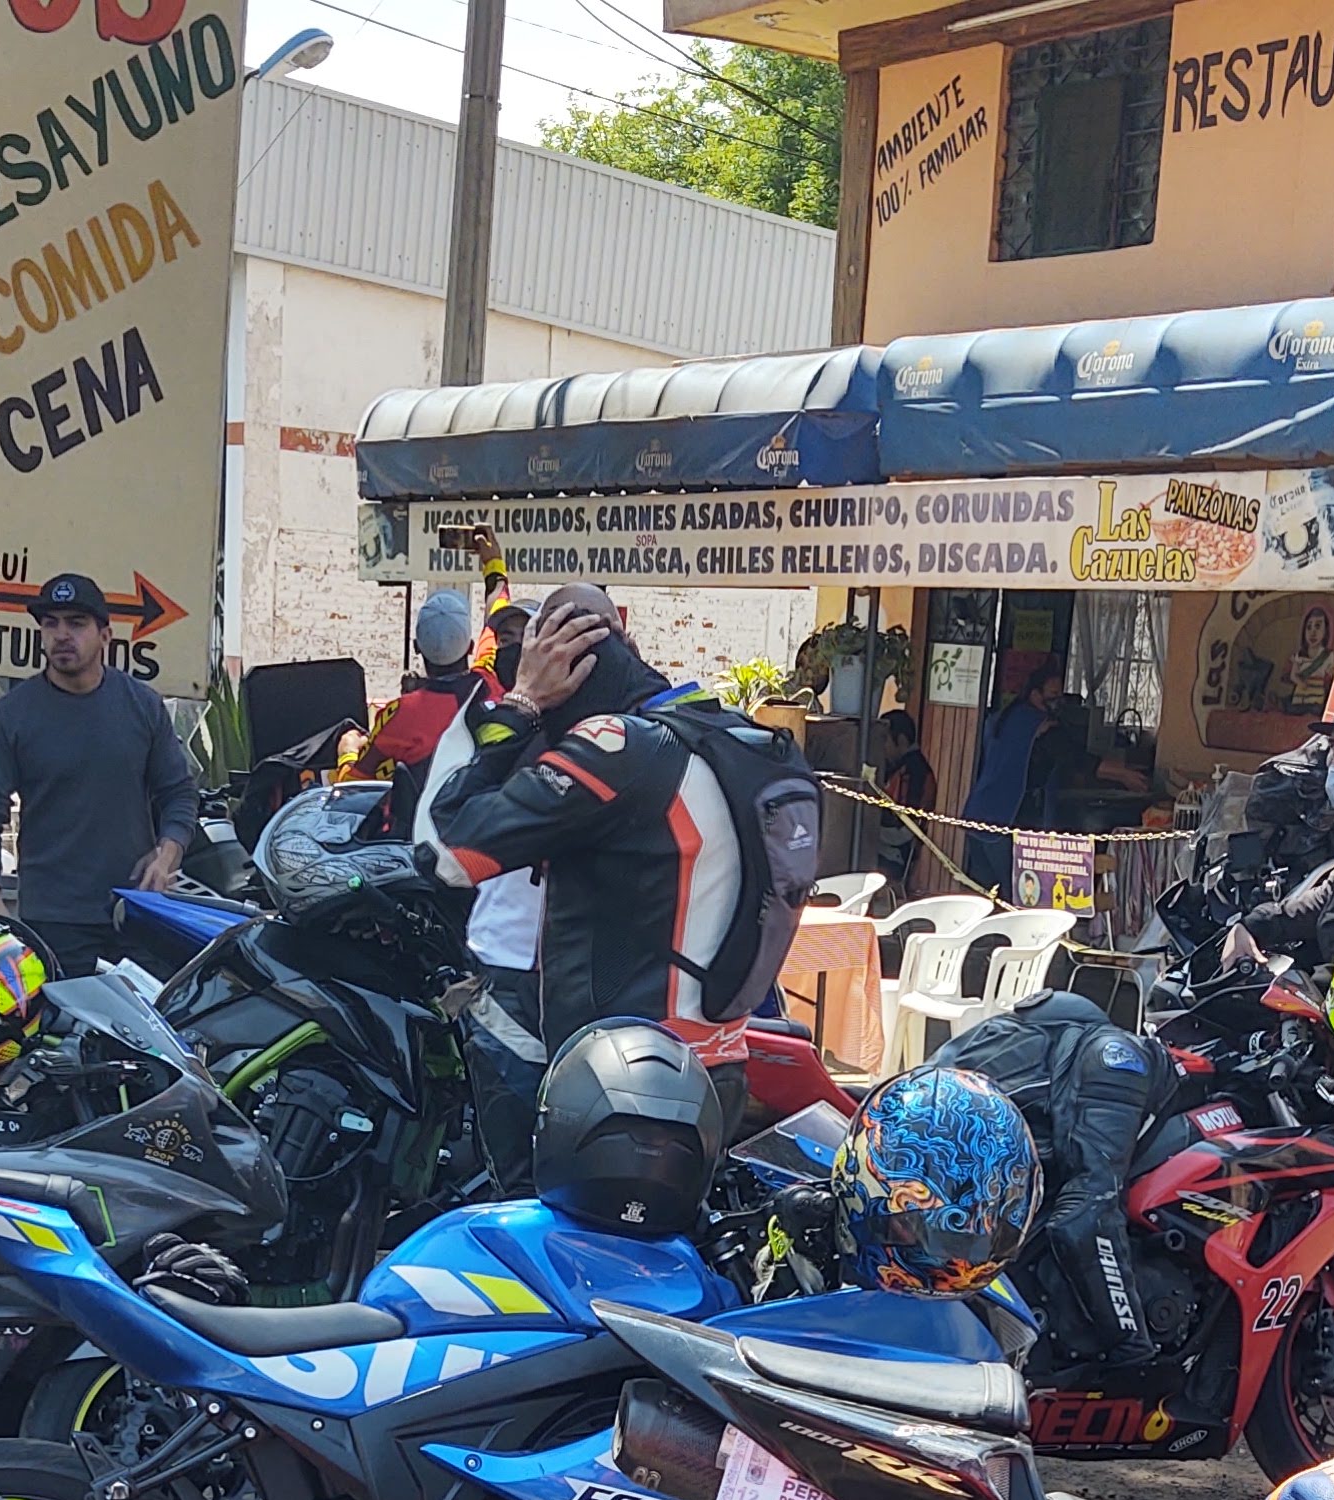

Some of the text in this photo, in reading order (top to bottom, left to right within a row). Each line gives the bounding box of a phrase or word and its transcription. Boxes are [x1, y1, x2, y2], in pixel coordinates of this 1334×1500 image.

[876, 75, 966, 178] AMBIENTE
[874, 106, 989, 228] 100% FAMILIAR
[895, 366, 943, 393] Corona
[1077, 352, 1134, 379] Corona
[1296, 357, 1319, 370] Extra
[757, 446, 799, 470] Corona
[494, 507, 591, 535] LICUADOS,
[597, 503, 677, 532] CARNES
[681, 500, 782, 532] ASADAS,
[915, 489, 1075, 524] CORUNDAS
[1095, 480, 1152, 542] Las
[1165, 478, 1261, 533] PANZONAS
[429, 542, 1058, 577] MOLE NCHERO, TARASCA, CHILES RELLENOS, DISCADA.
[635, 535, 658, 546] SOPA
[1070, 526, 1197, 582] Cazuelas
[1202, 639, 1228, 706] Las
[149, 1119, 192, 1142] TRADING
[1096, 1236, 1138, 1331] DAINESE
[1252, 1274, 1303, 1332] 22
[779, 1419, 851, 1450] 1000
